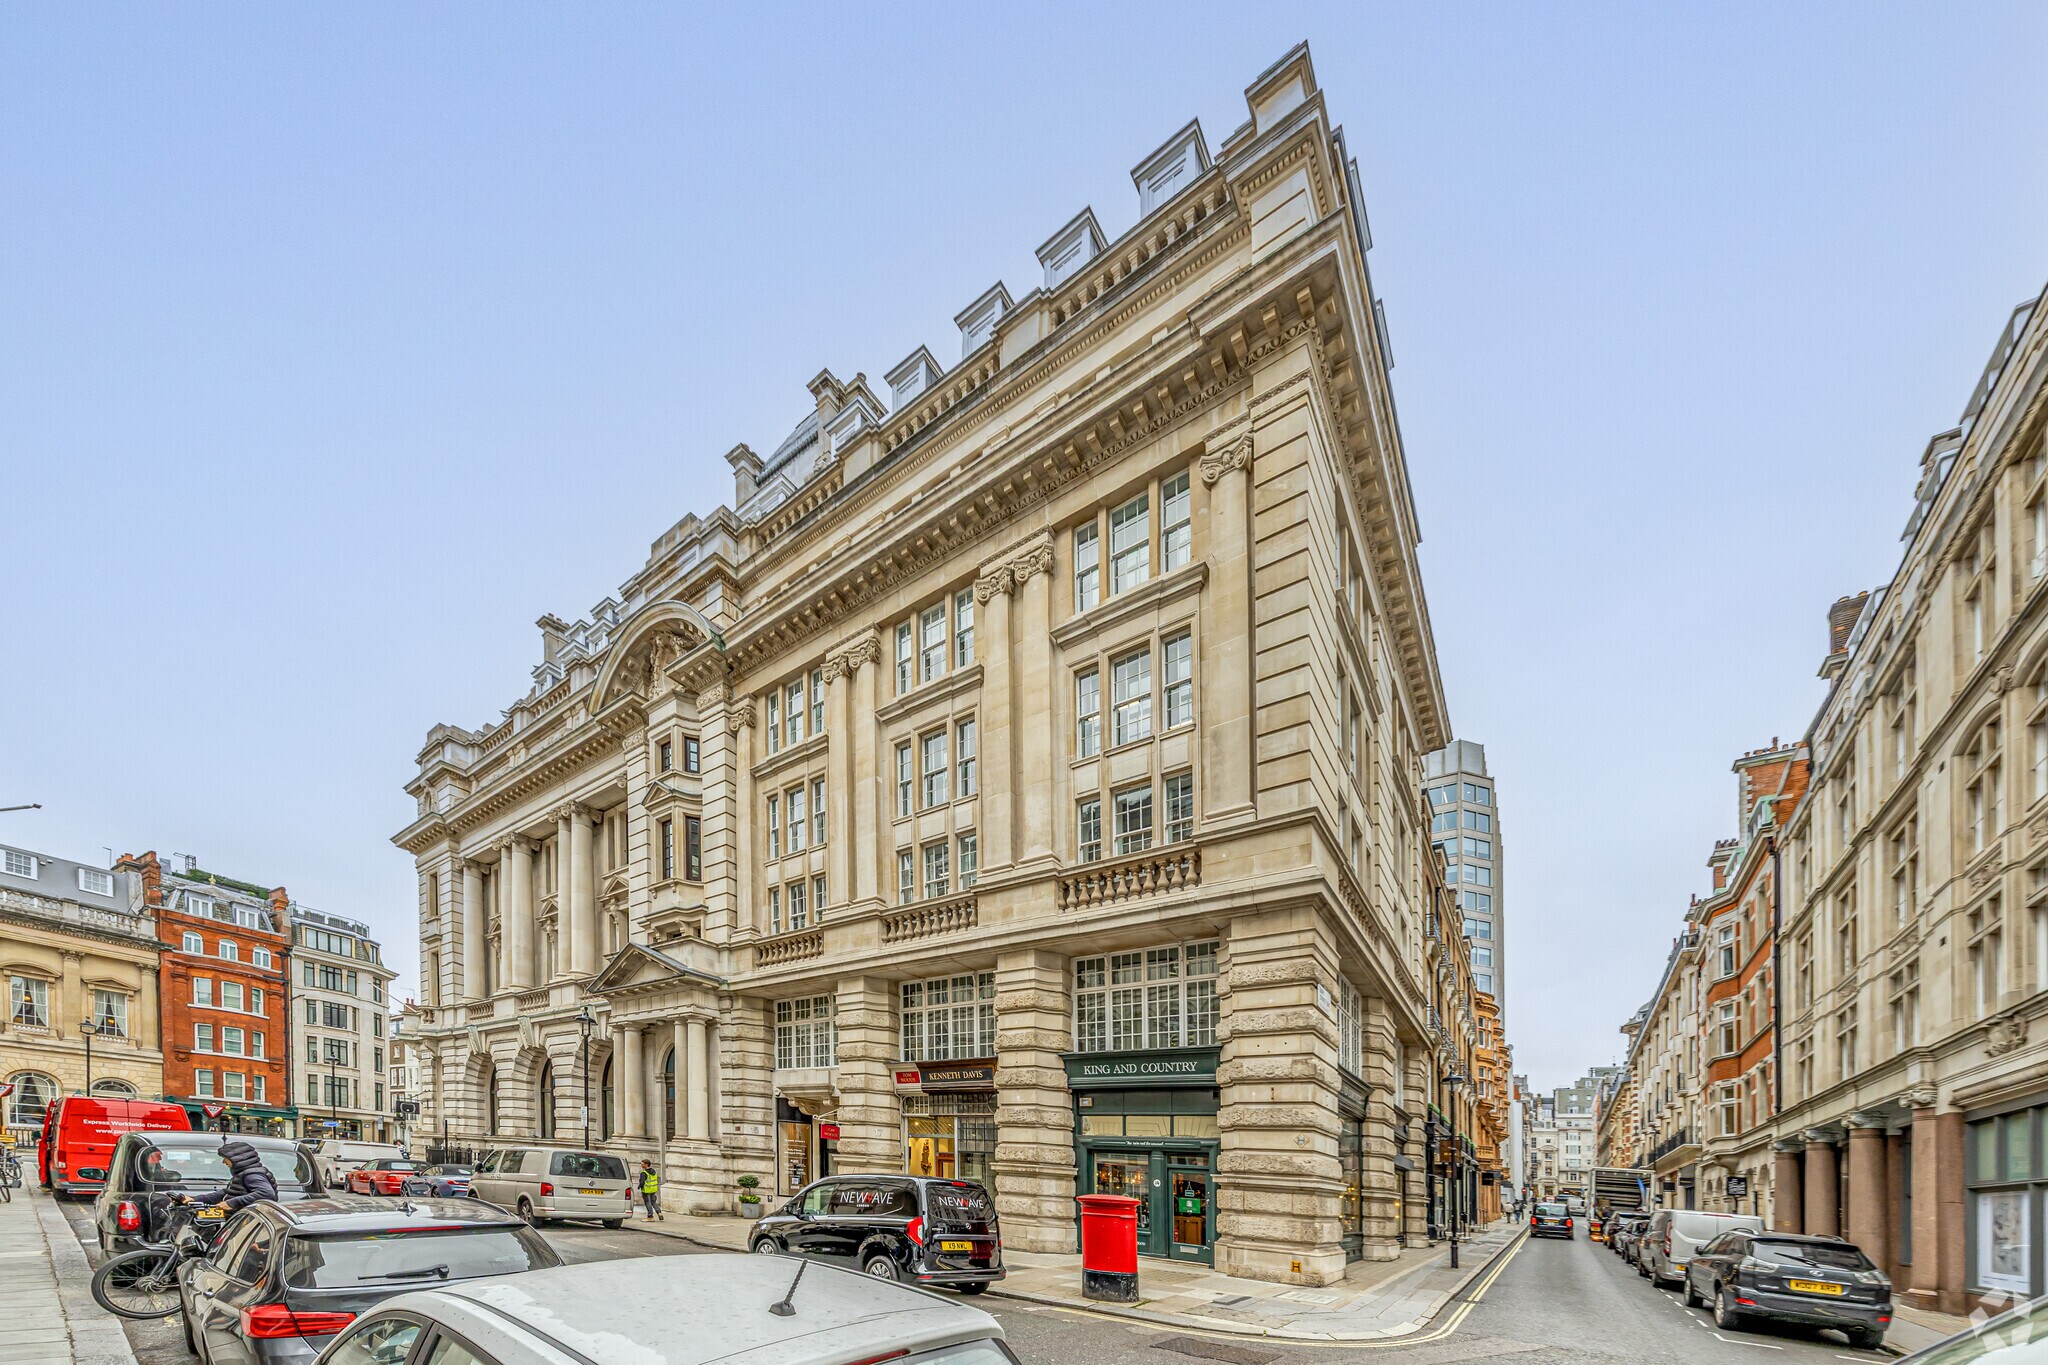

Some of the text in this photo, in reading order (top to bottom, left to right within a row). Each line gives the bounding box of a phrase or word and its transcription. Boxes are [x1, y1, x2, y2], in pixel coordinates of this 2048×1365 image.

[1083, 1061, 1198, 1075] KING AND COUNTRY
[929, 1070, 984, 1080] KENNETH DAVIS
[83, 1119, 172, 1130] Express Worldwide Delivery
[947, 1242, 967, 1250] X9 NWL
